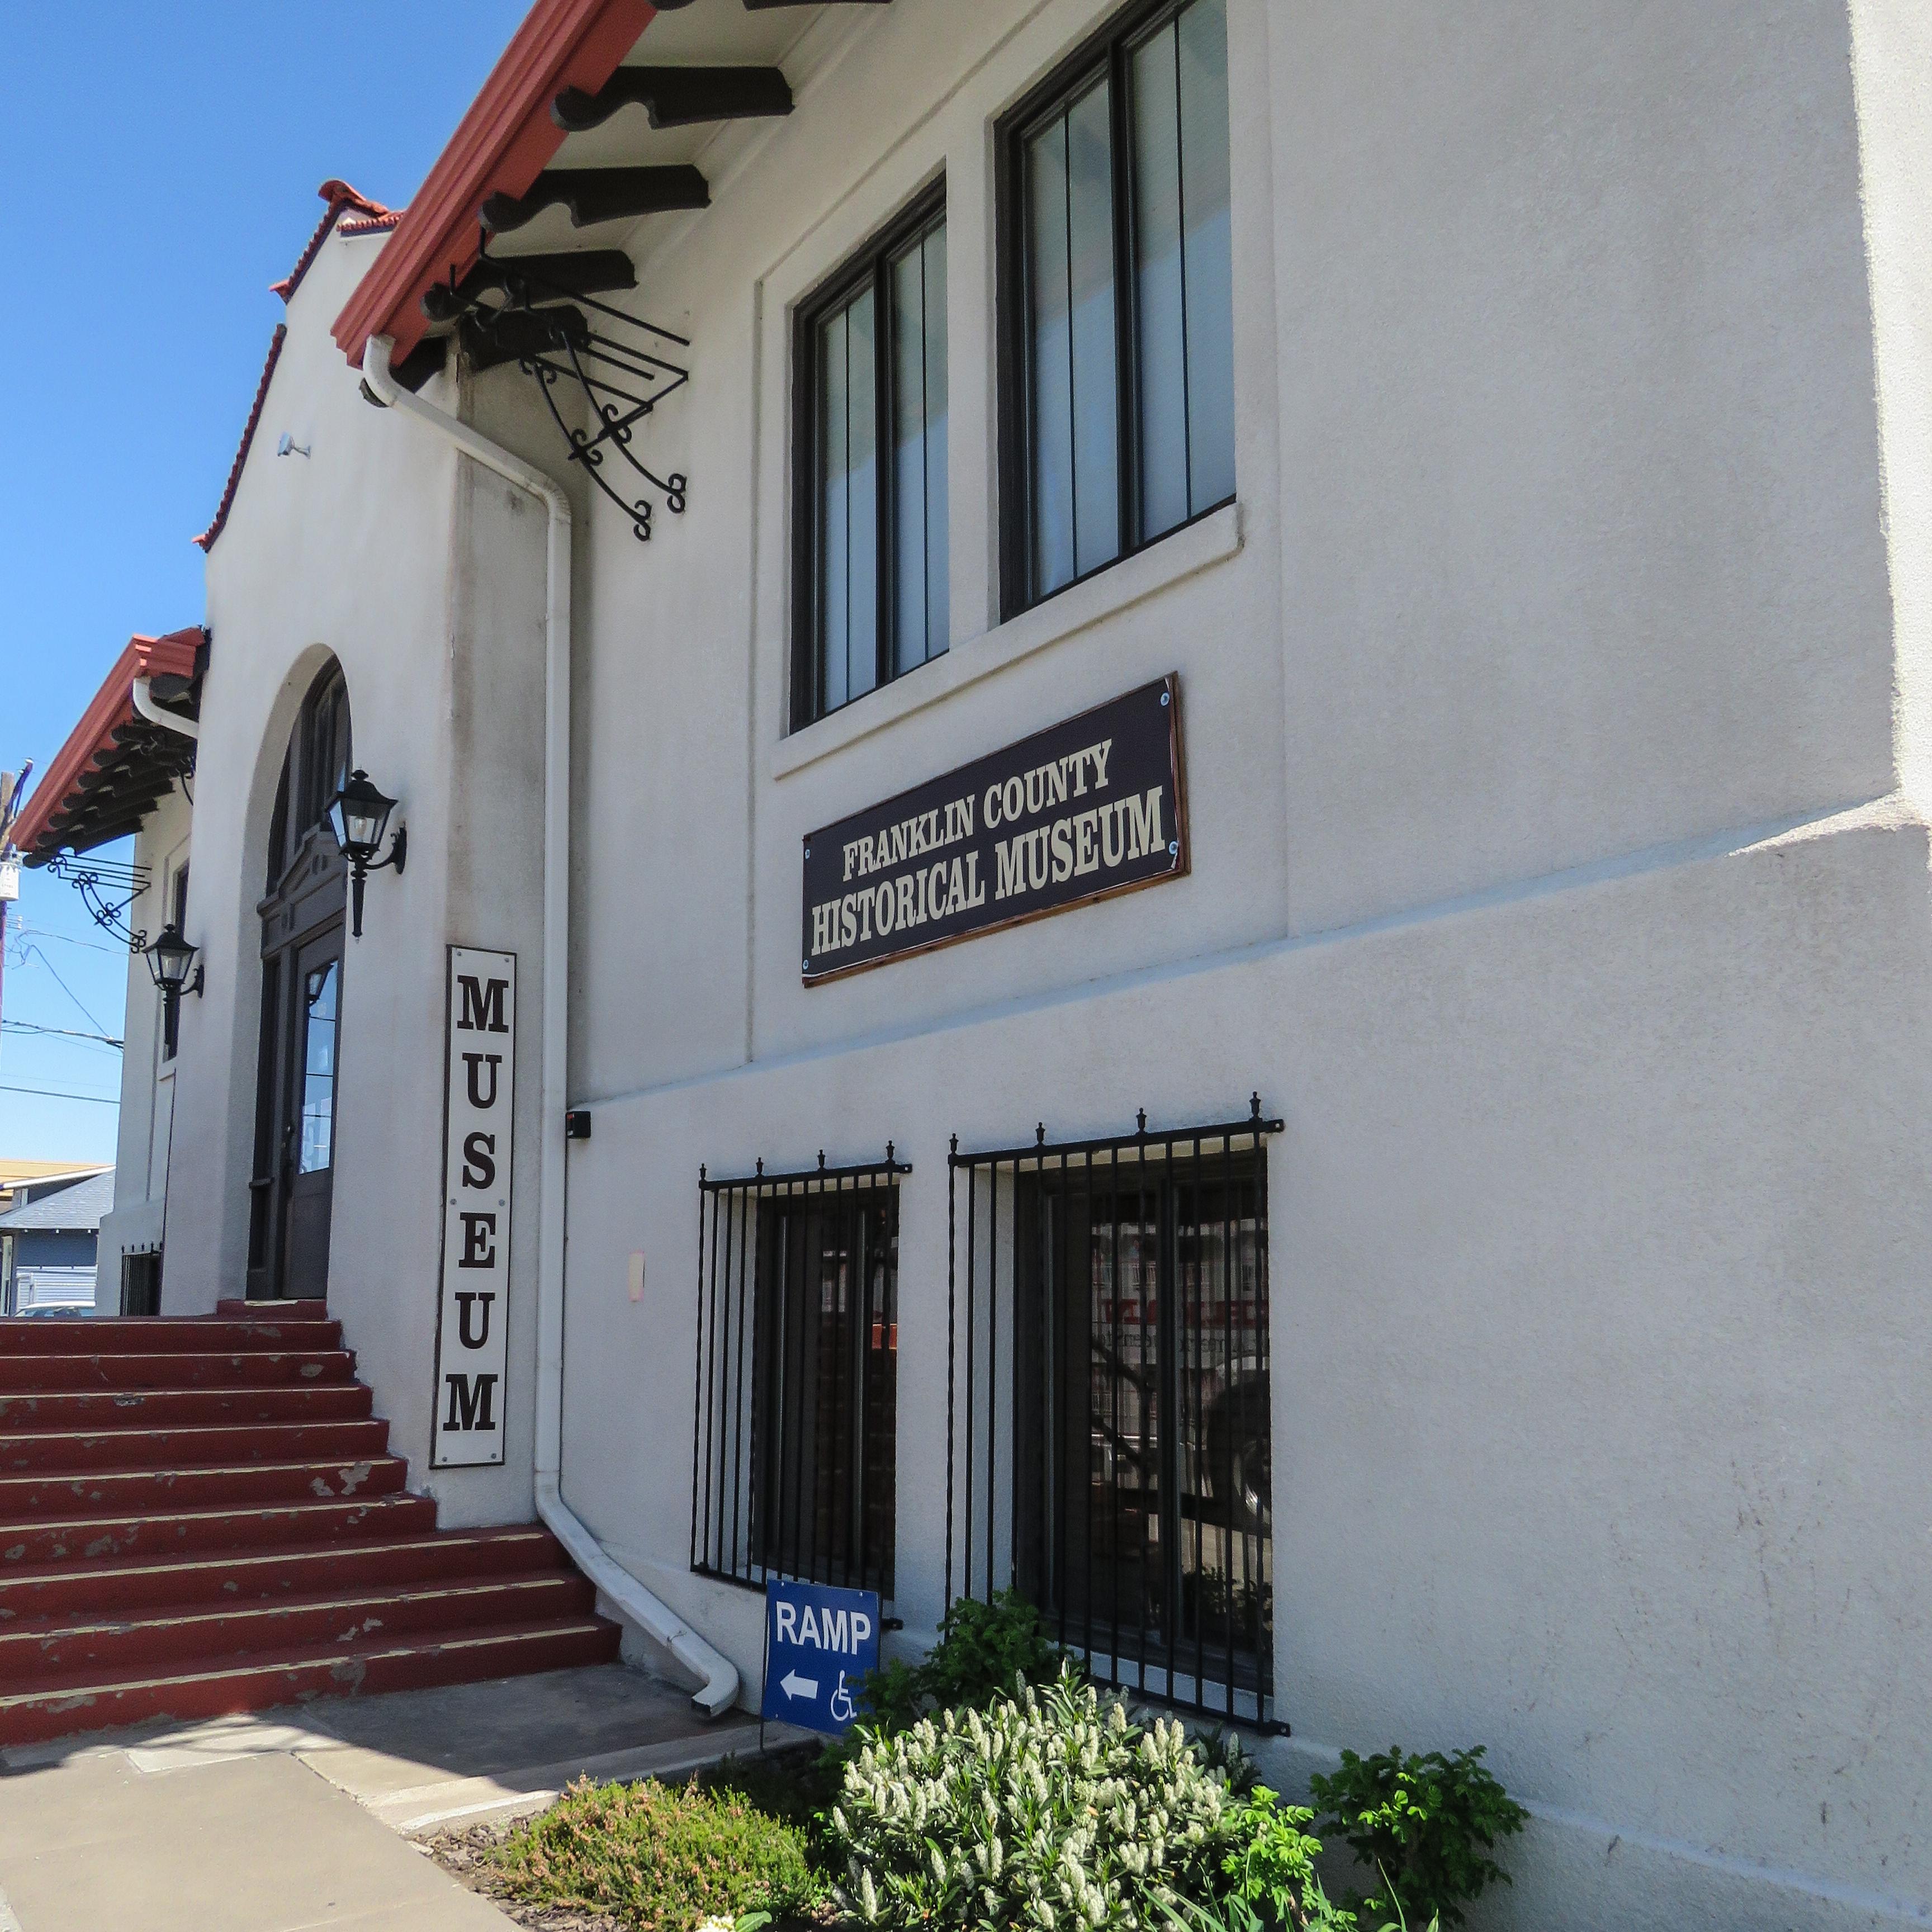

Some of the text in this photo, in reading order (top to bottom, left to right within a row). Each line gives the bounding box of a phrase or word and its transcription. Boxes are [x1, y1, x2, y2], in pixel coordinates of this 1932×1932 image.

[811, 785, 1166, 956] HISTORICAL MUSEUM
[843, 738, 1112, 882] FRANKLIN COUNTY
[443, 975, 510, 1431] MUSEUM
[776, 1600, 871, 1655] RAMP
